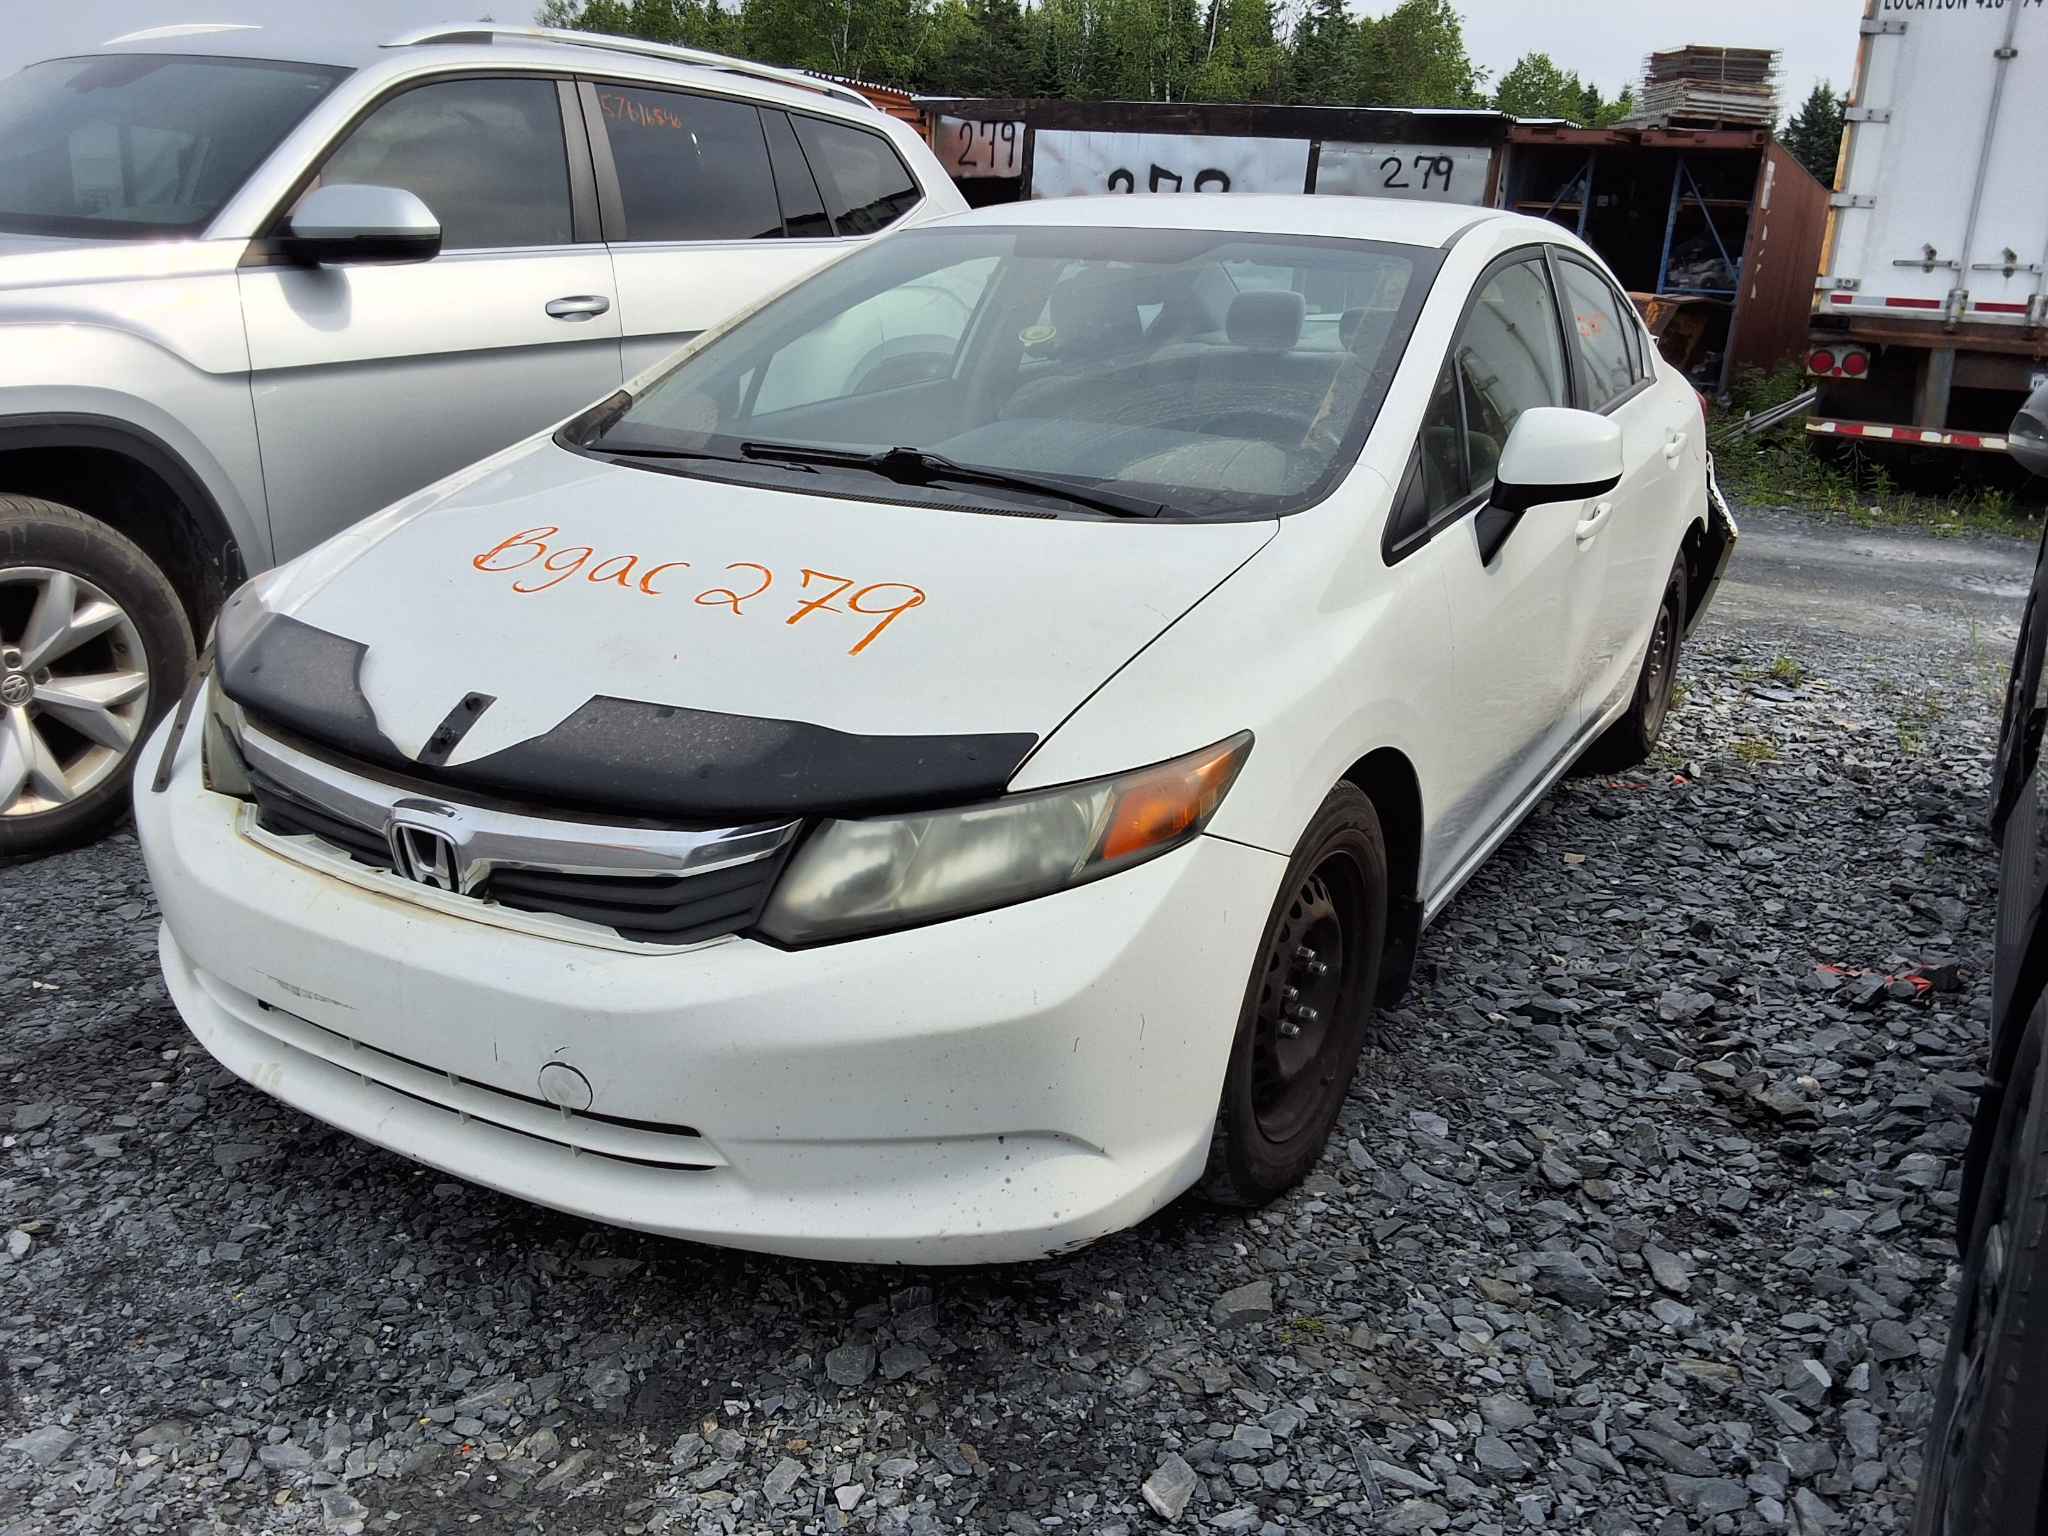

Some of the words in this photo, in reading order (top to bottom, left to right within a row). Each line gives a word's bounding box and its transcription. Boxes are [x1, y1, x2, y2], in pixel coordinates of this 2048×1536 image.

[958, 120, 1016, 168] 279
[1379, 155, 1454, 192] 279
[694, 562, 926, 656] 279
